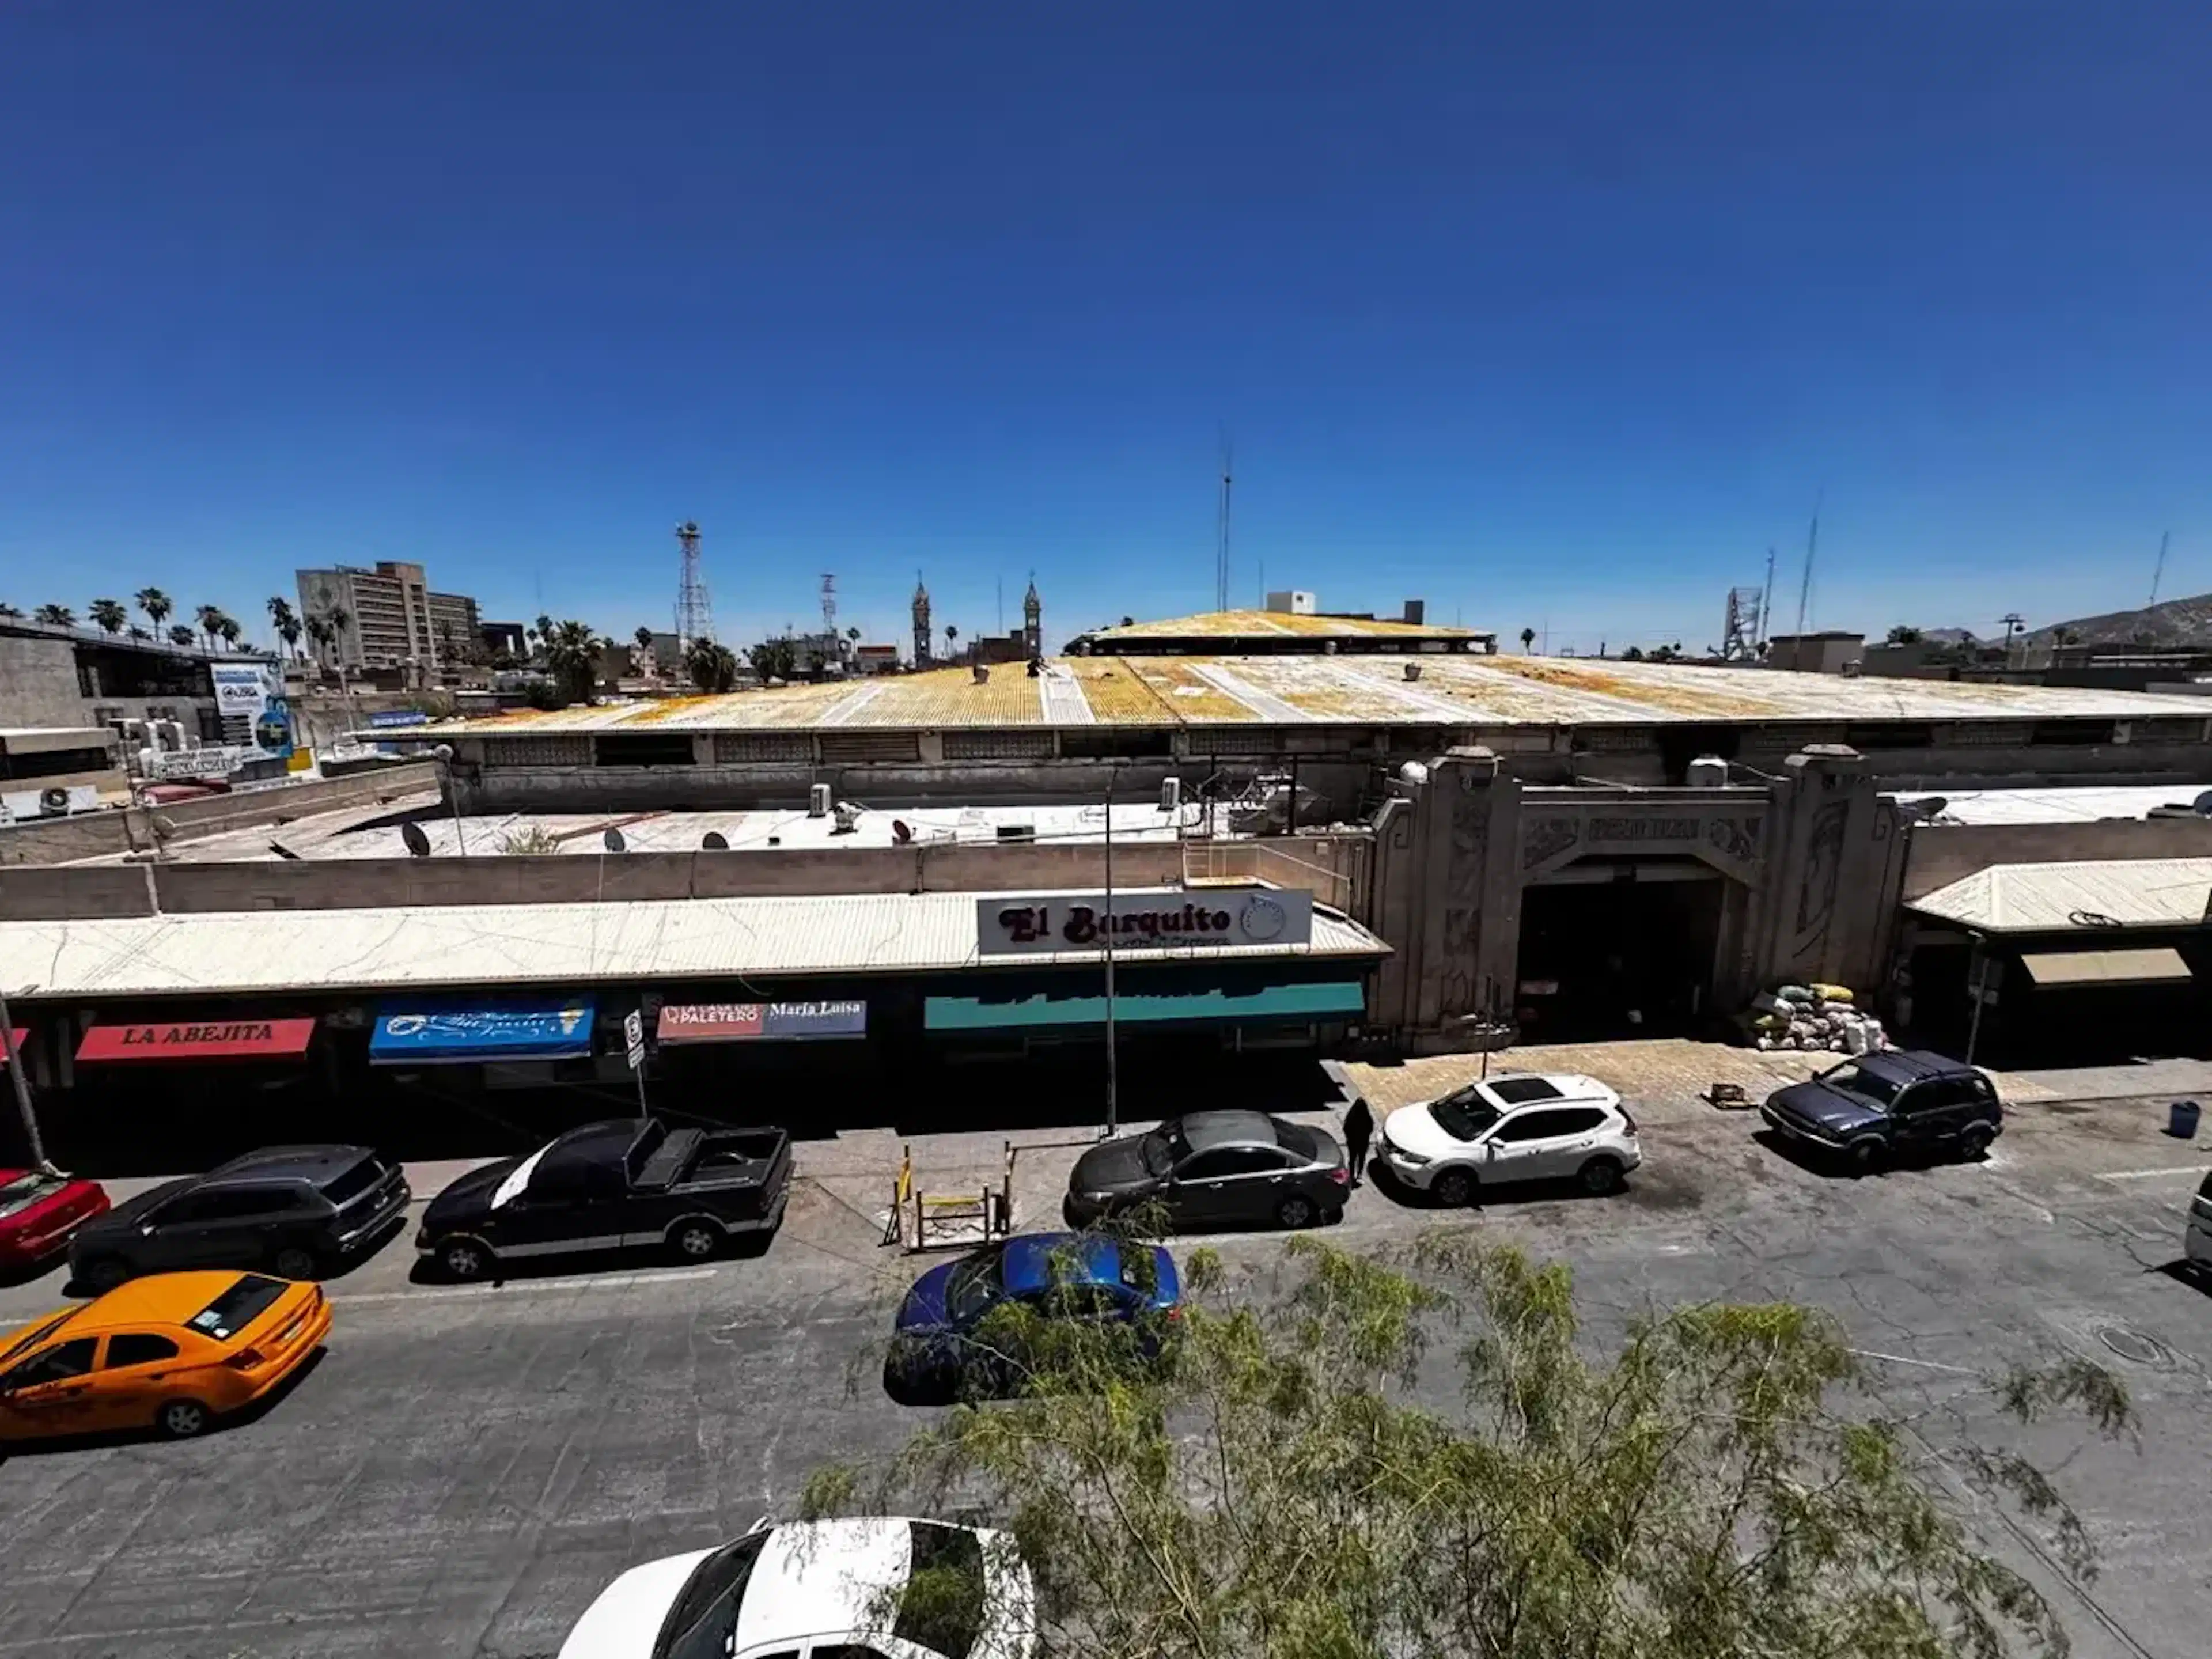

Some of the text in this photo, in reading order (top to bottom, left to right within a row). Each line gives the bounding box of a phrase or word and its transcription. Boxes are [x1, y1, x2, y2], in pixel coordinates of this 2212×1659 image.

[998, 904, 1050, 942] El
[1063, 902, 1232, 944] Barquito
[680, 1011, 759, 1024] PALETERO
[819, 1000, 861, 1017] Luisa
[120, 1024, 272, 1045] LA ABEJITA
